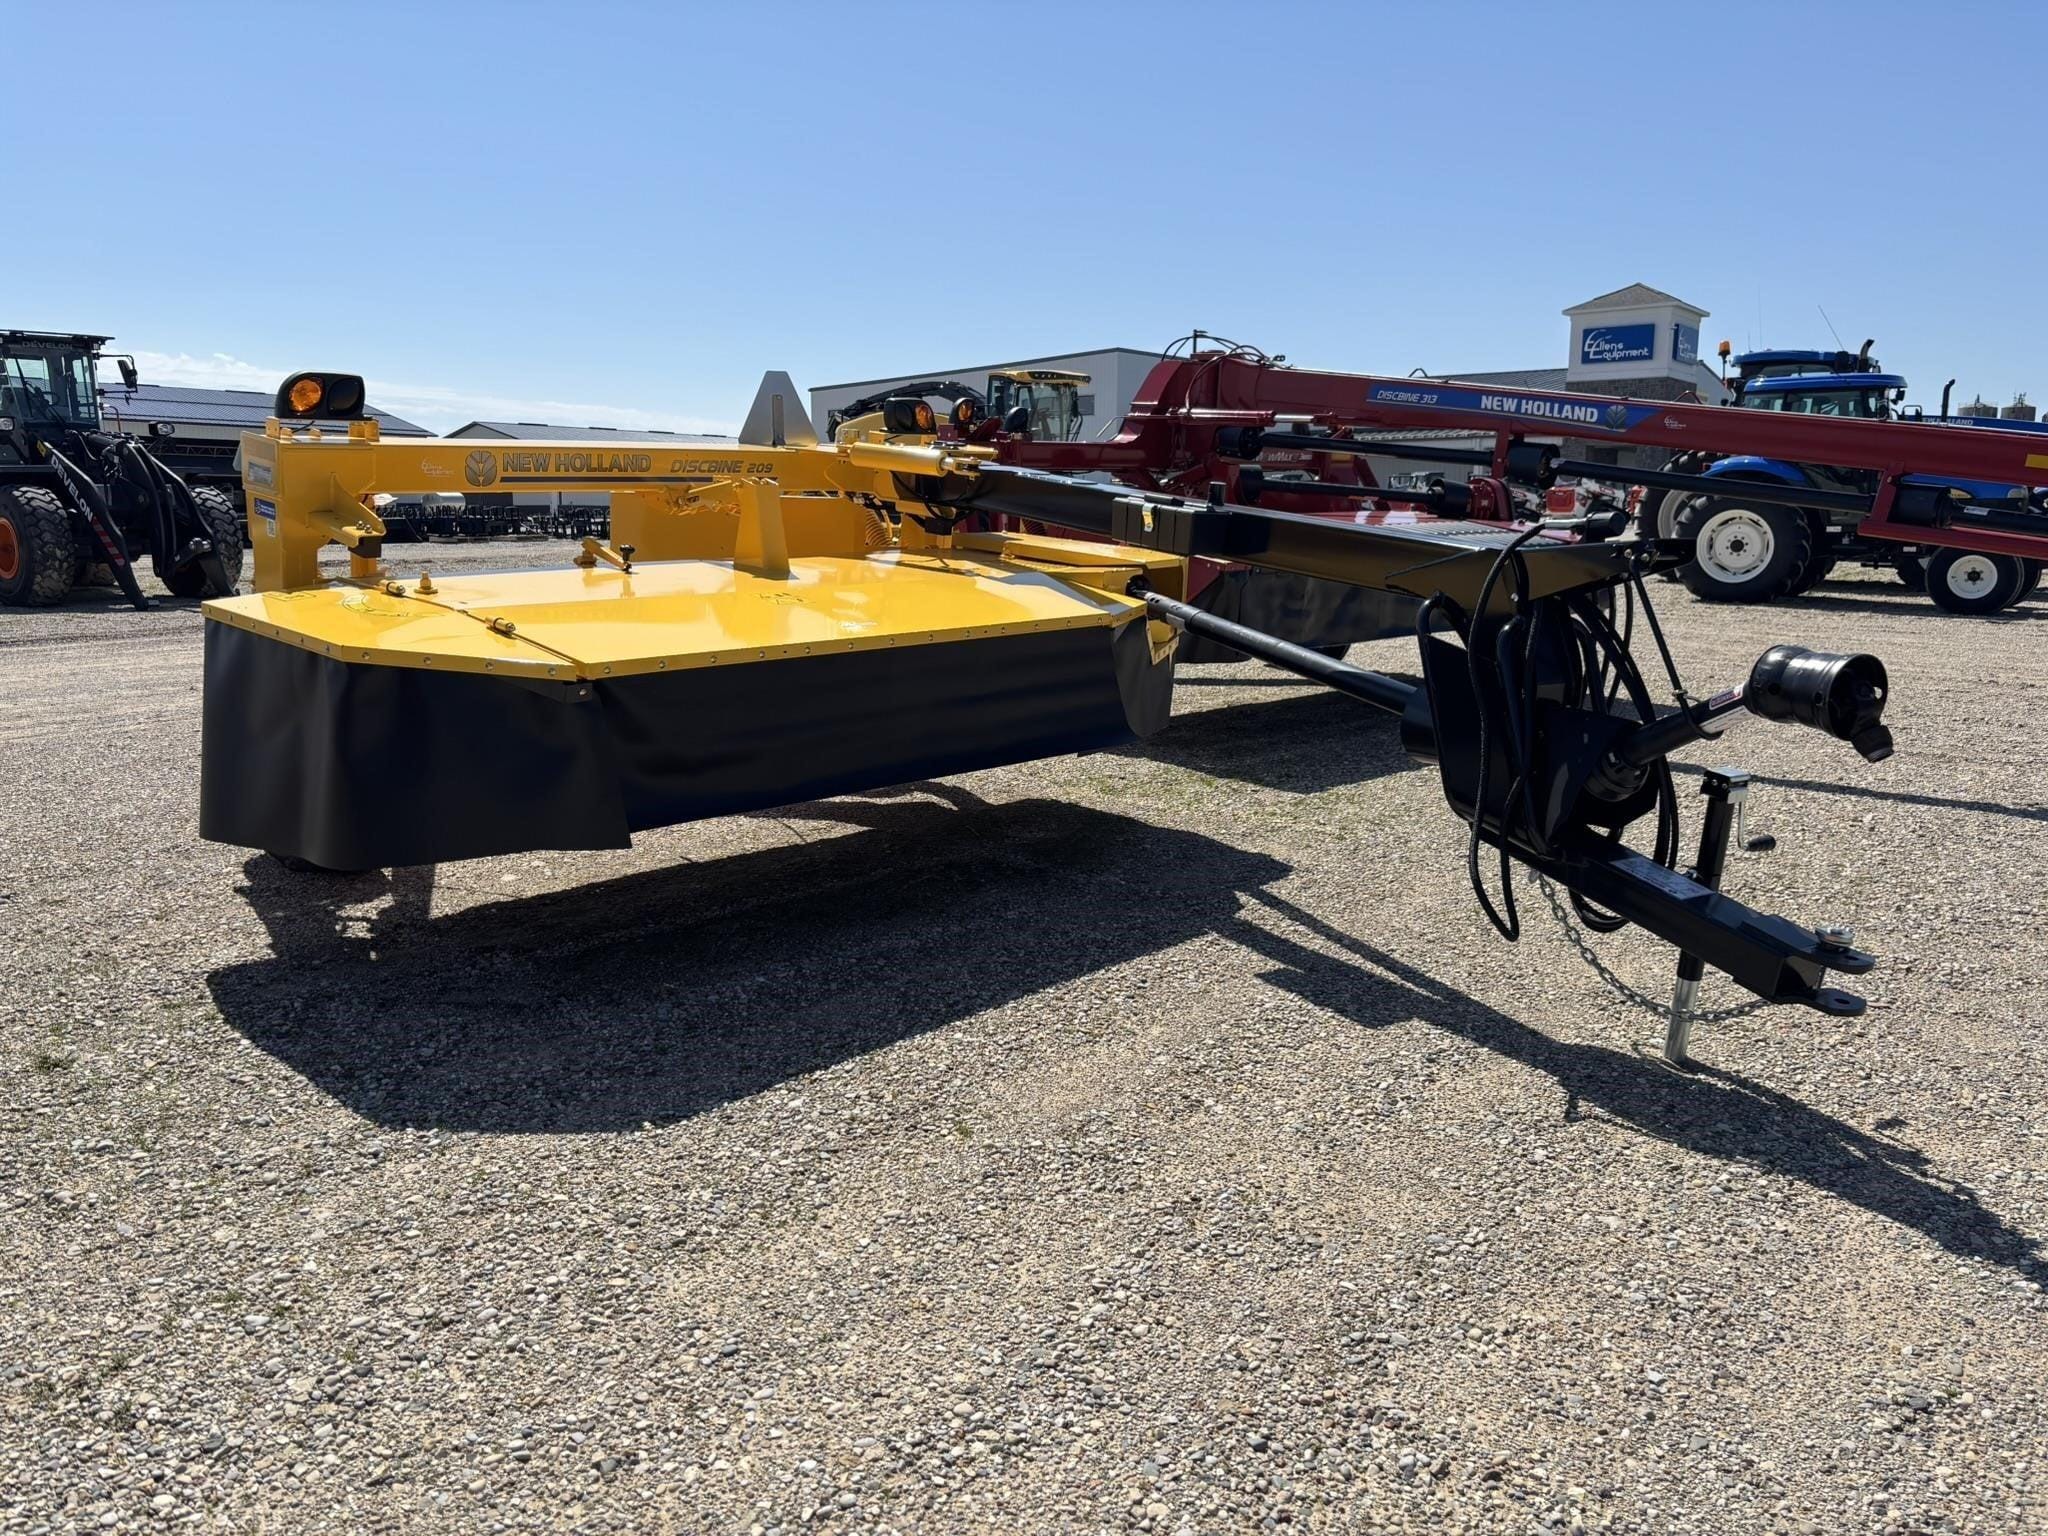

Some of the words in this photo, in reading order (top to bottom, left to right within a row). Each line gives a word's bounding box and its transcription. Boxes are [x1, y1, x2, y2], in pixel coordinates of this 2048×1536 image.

[1377, 390, 1420, 402] DISCBINE
[1420, 394, 1438, 404] 313
[1481, 395, 1516, 411] NEW
[1521, 400, 1598, 423] HOLLAND
[502, 453, 550, 473] NEW
[554, 454, 651, 473] HOLLAND
[670, 460, 744, 473] DISCBINE
[746, 463, 774, 473] 209
[51, 454, 93, 522] DEVELON
